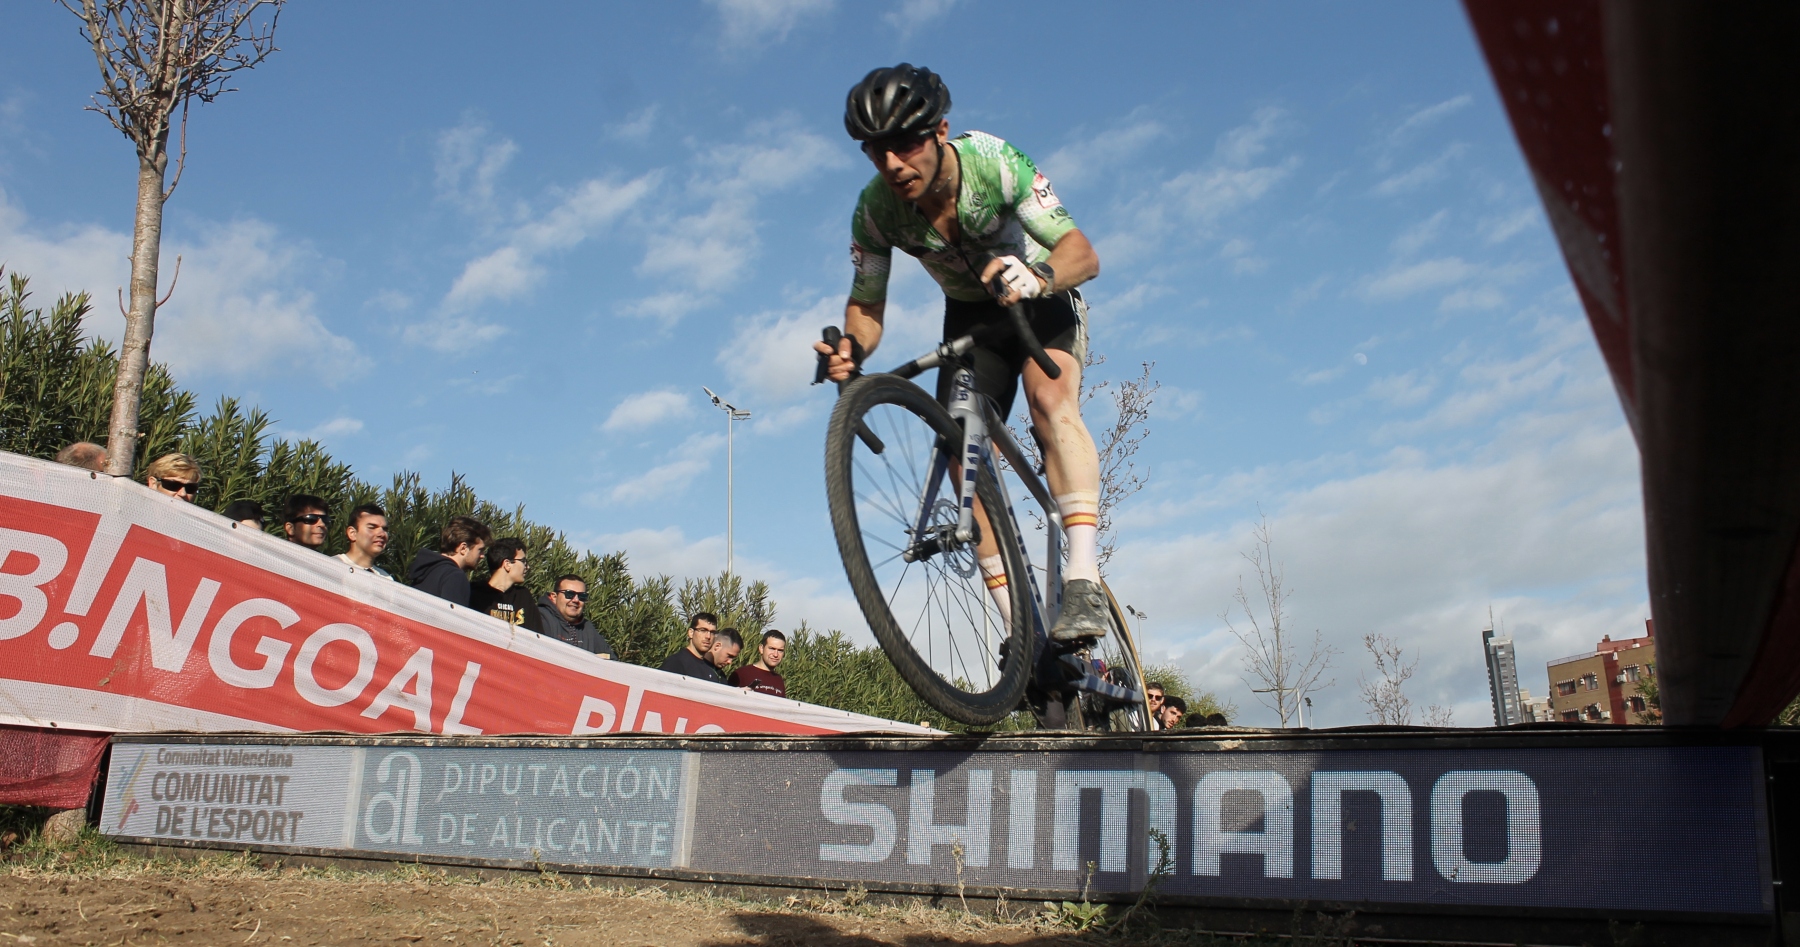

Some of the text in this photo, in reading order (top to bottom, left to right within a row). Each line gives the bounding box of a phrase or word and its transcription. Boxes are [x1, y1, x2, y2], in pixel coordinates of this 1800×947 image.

[157, 748, 293, 768] Comunitat Valenciana
[151, 771, 290, 806] COMUNITAT
[434, 757, 674, 801] DIPUTACIÓN
[155, 805, 190, 836] DE
[436, 812, 670, 857] DE ALICANTE
[819, 768, 1542, 885] SHIMANO
